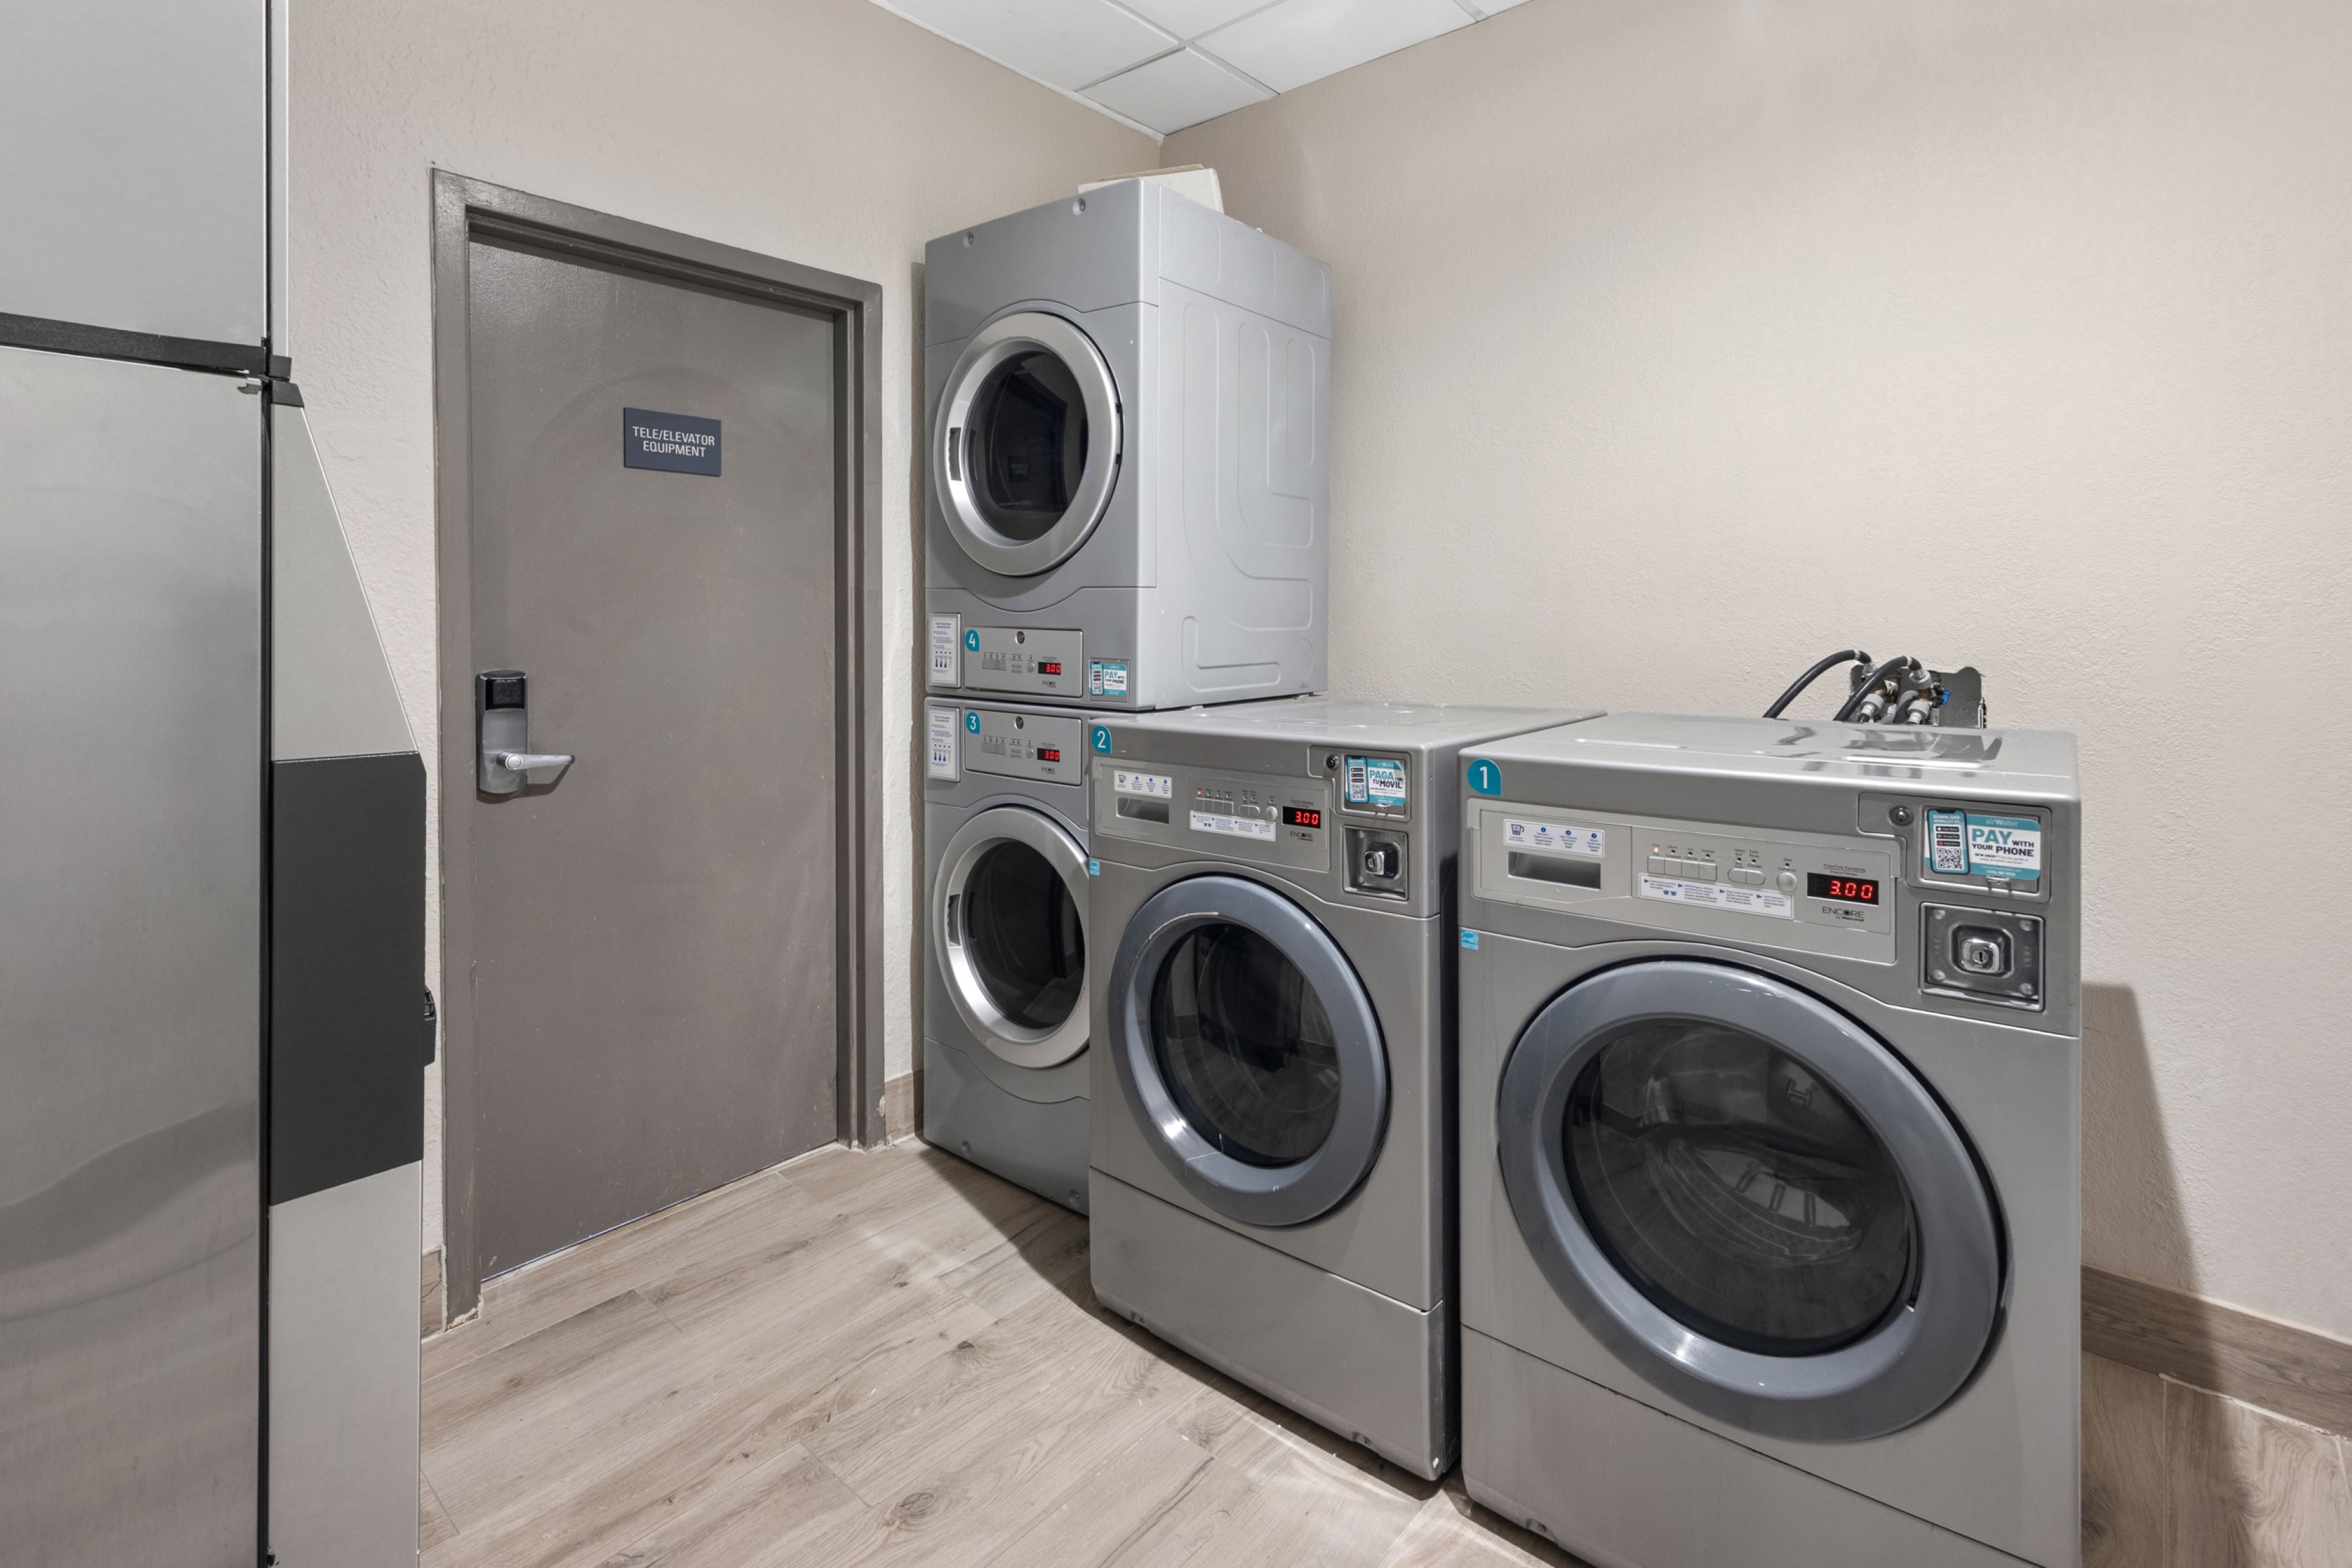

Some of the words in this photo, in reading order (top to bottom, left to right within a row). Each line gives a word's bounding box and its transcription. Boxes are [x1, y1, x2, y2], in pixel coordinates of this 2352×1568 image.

[632, 426, 715, 446] TELE/ELEVATOR
[643, 441, 706, 458] EQUIPMENT
[968, 633, 976, 648] 4
[1105, 670, 1118, 679] PAY
[970, 715, 976, 730] 3
[1097, 730, 1106, 748] 2
[1370, 770, 1394, 781] PAGA
[1479, 766, 1488, 789] 1
[1295, 811, 1318, 825] 3.00
[1985, 819, 2018, 827] airWallet
[1972, 828, 2013, 845] PAY
[2012, 840, 2035, 848] WITH
[1995, 846, 2035, 857] PHONE
[1829, 879, 1874, 899] 3.00
[1822, 906, 1865, 918] ENCORE
